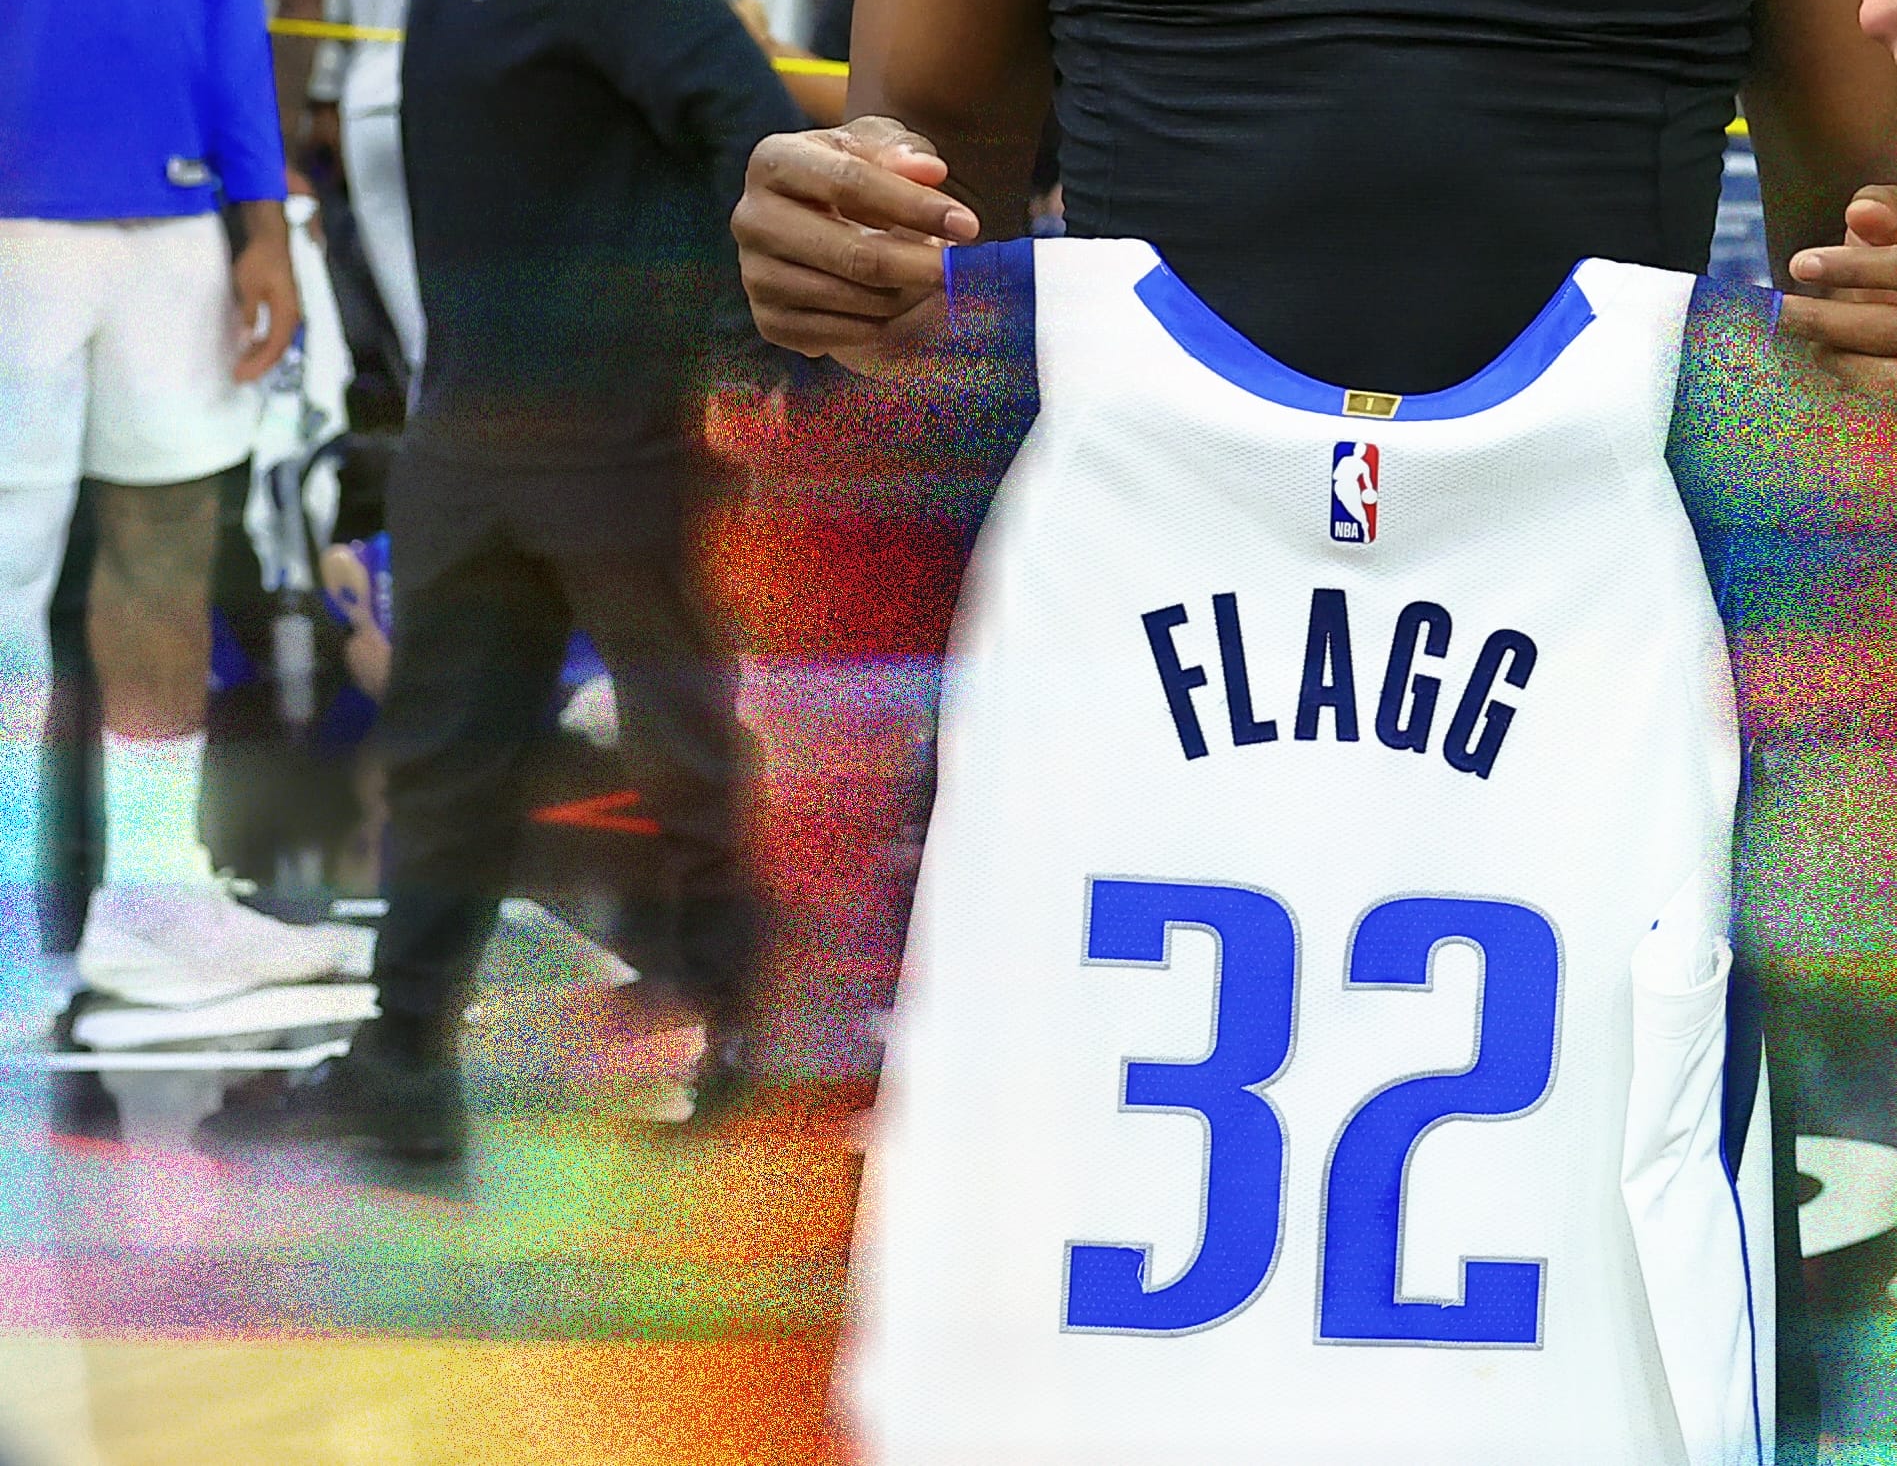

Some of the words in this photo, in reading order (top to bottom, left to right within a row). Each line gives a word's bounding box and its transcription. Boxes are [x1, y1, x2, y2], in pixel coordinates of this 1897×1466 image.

[1335, 521, 1359, 539] NBA
[1141, 587, 1539, 781] FLAGG
[1060, 872, 1567, 1351] 32
